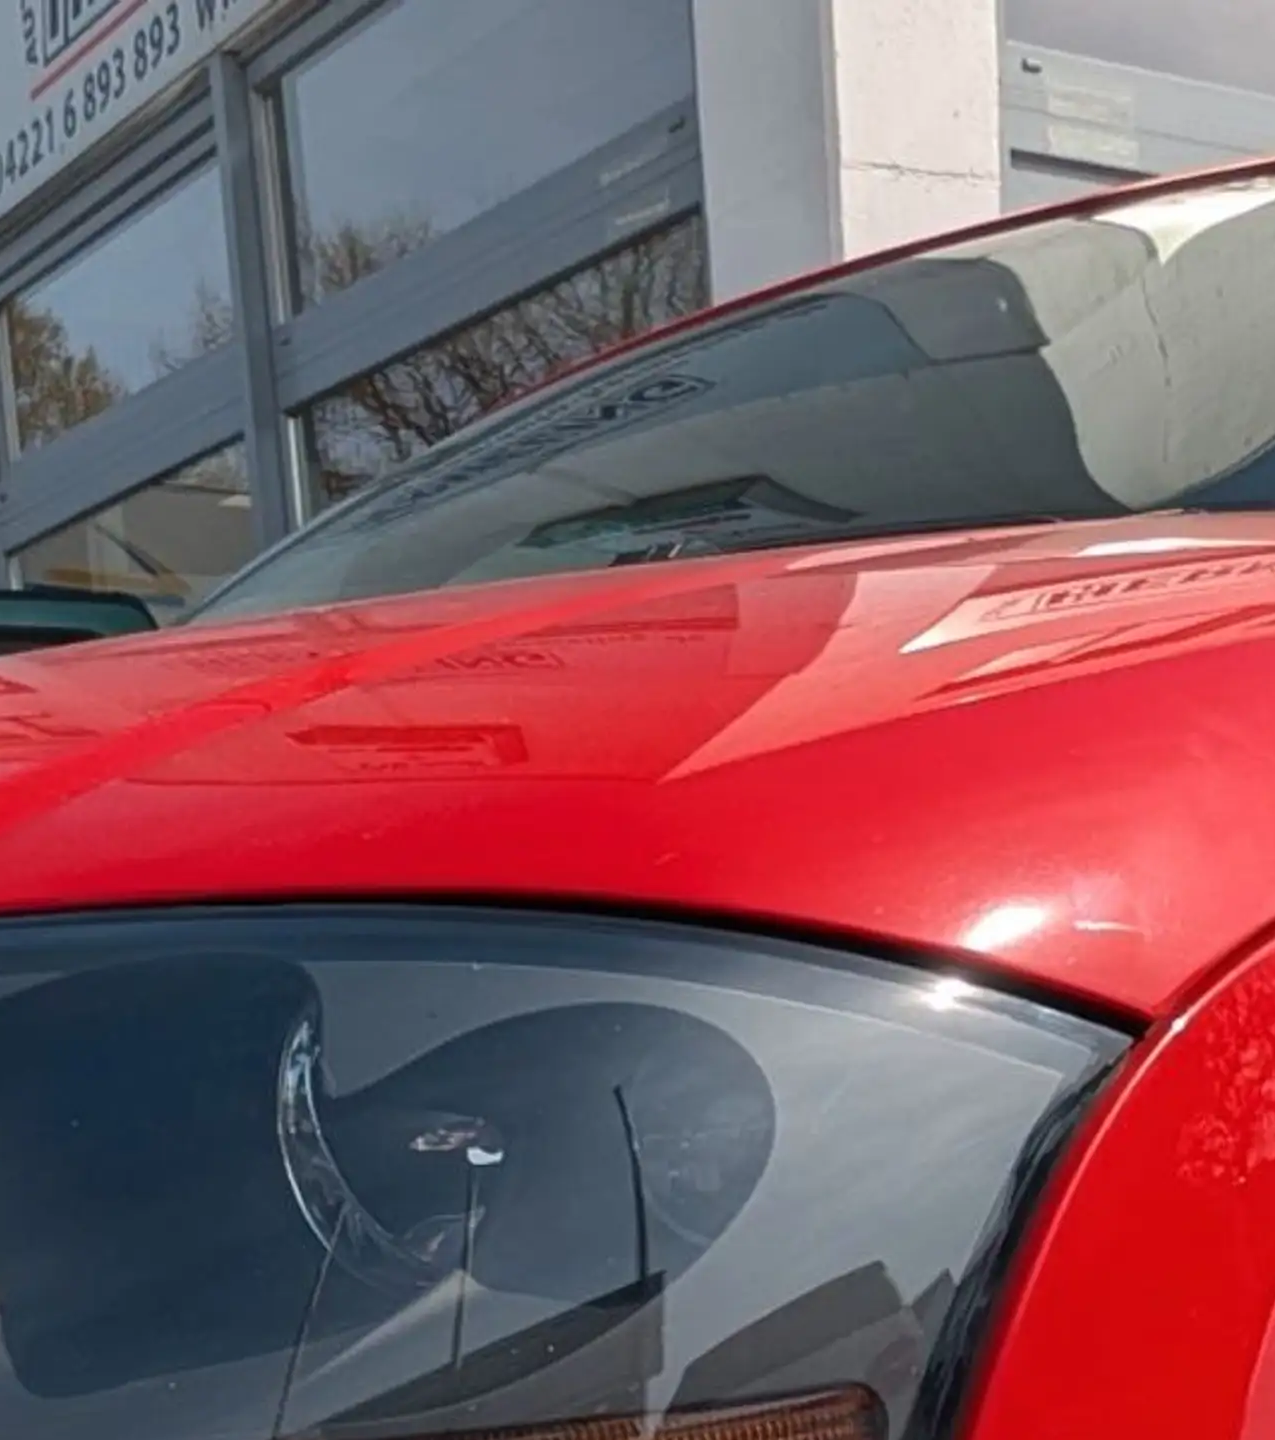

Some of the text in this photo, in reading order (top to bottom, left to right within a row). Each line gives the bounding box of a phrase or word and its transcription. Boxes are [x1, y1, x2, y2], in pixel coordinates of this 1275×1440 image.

[63, 88, 77, 139] 6
[82, 47, 126, 123] 893
[133, 2, 181, 82] 893
